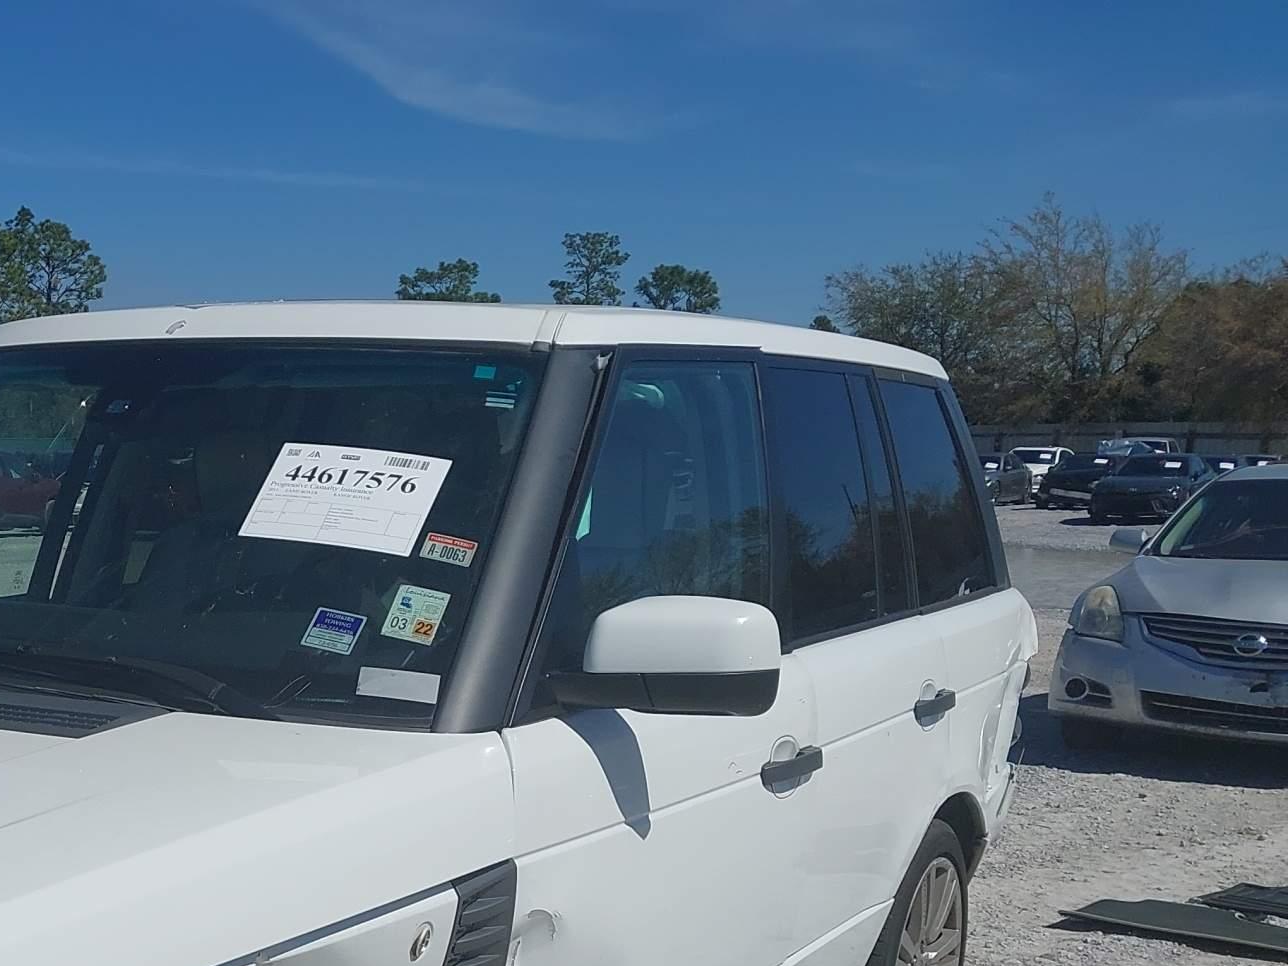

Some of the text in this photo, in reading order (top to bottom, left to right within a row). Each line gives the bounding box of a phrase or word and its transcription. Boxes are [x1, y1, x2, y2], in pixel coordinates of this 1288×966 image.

[285, 464, 422, 494] 44617576
[427, 543, 468, 563] A-0063
[406, 586, 446, 602] Louisiana
[324, 618, 352, 629] TOWING
[390, 615, 433, 636] 03 22
